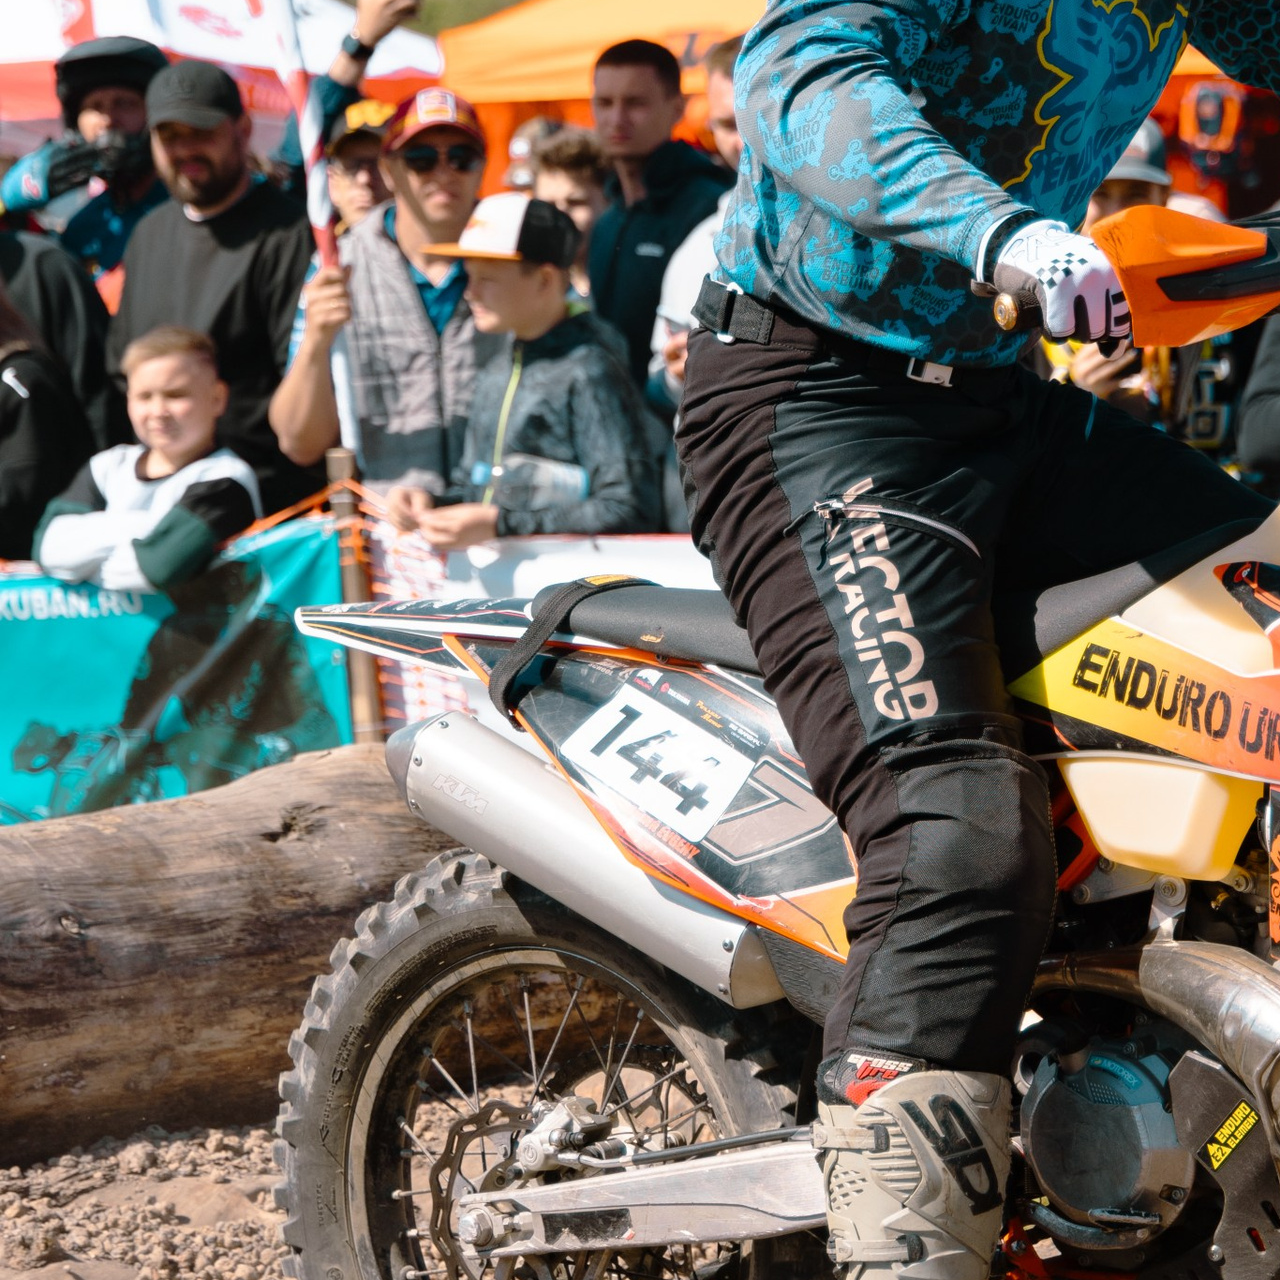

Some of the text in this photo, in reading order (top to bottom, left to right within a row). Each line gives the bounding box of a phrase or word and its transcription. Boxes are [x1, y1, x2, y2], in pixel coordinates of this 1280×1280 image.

[990, 2, 1040, 23] ENDURO
[982, 102, 1021, 117] ENDURO
[911, 285, 950, 312] ENDURO
[1072, 641, 1232, 741] ENDURO
[430, 773, 489, 816] KTM
[847, 1053, 914, 1072] cross
[1101, 1058, 1139, 1087] MOTOREX
[1214, 1101, 1252, 1144] ENDURO
[1226, 1110, 1260, 1149] ELEMENT
[1211, 1146, 1227, 1162] E2
